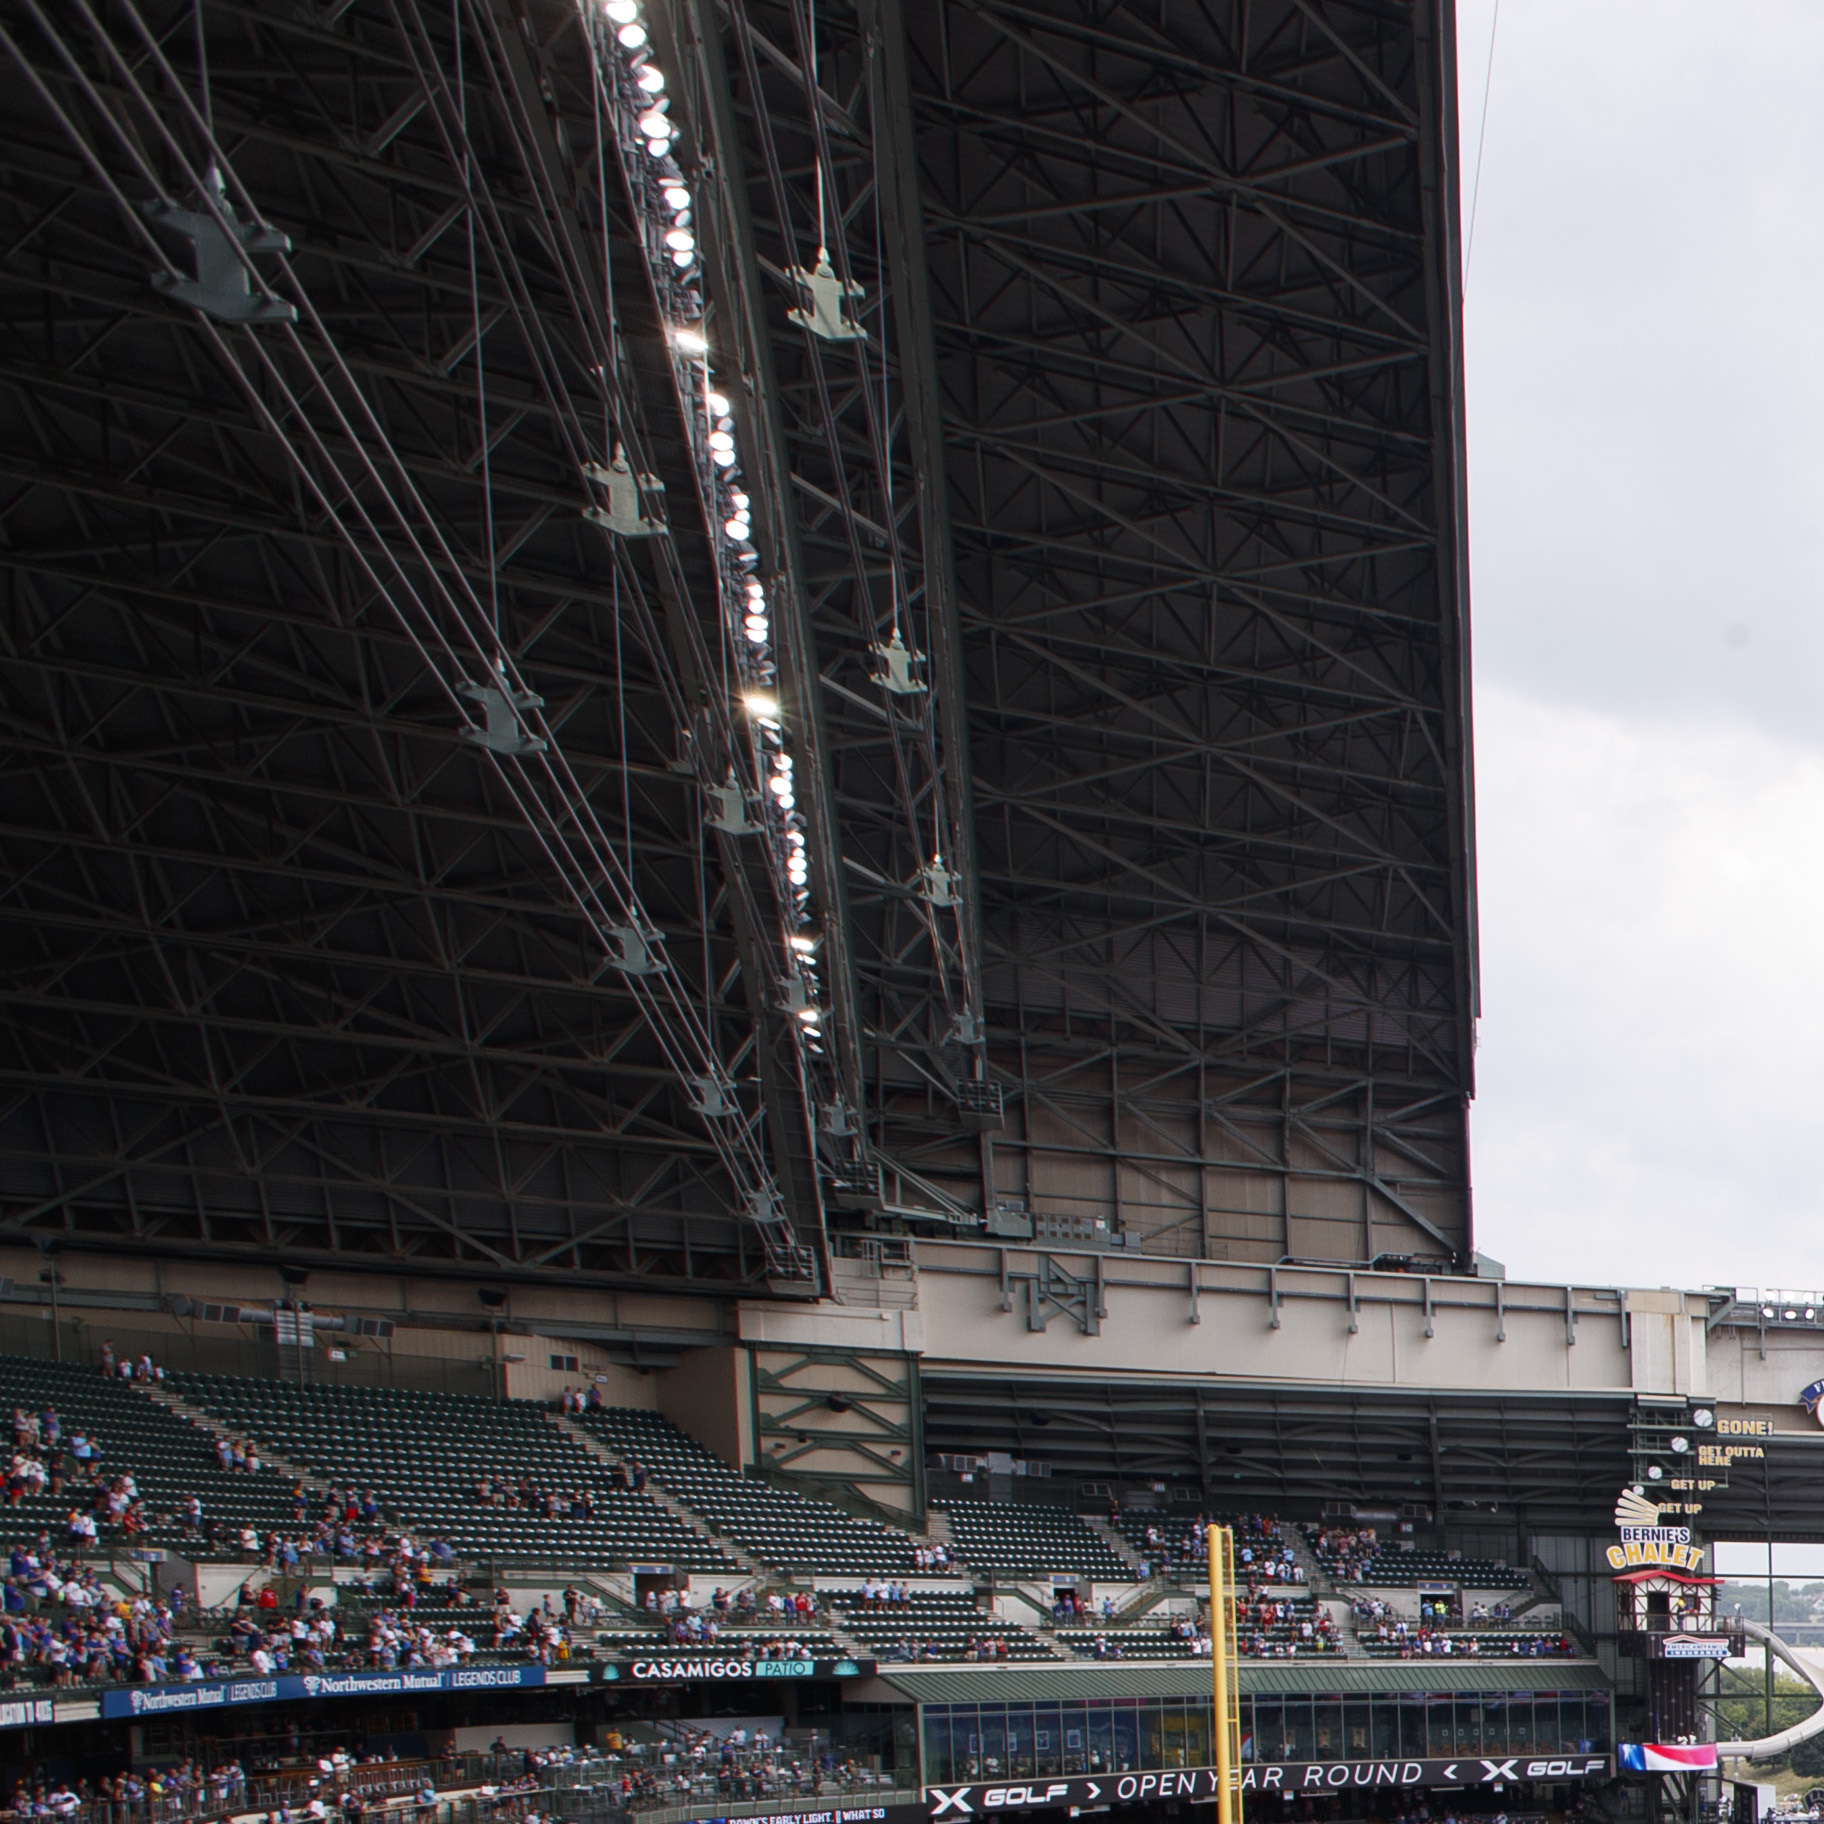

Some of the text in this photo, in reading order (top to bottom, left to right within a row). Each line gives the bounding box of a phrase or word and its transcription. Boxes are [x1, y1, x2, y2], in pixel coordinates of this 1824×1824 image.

[1717, 1419, 1773, 1435] GONE!
[1699, 1446, 1764, 1458] GET OUTTA
[1699, 1456, 1731, 1466] HERE
[1671, 1479, 1716, 1491] GET UP
[1658, 1502, 1702, 1514] GET UP
[1622, 1527, 1689, 1542] BERNIE'S
[1606, 1543, 1704, 1570] CHALET
[632, 1660, 806, 1678] CASAMIGOS PATIO
[320, 1674, 442, 1693] Northwestern Mutual
[453, 1670, 522, 1686] LEGENDS CLUB
[142, 1690, 196, 1710] Northwestern
[1526, 1760, 1605, 1776] GOLF
[1117, 1762, 1422, 1799] OPEN ROUND
[983, 1784, 1068, 1806] GOLF
[843, 1809, 870, 1822] WHAT
[872, 1808, 885, 1819] SO
